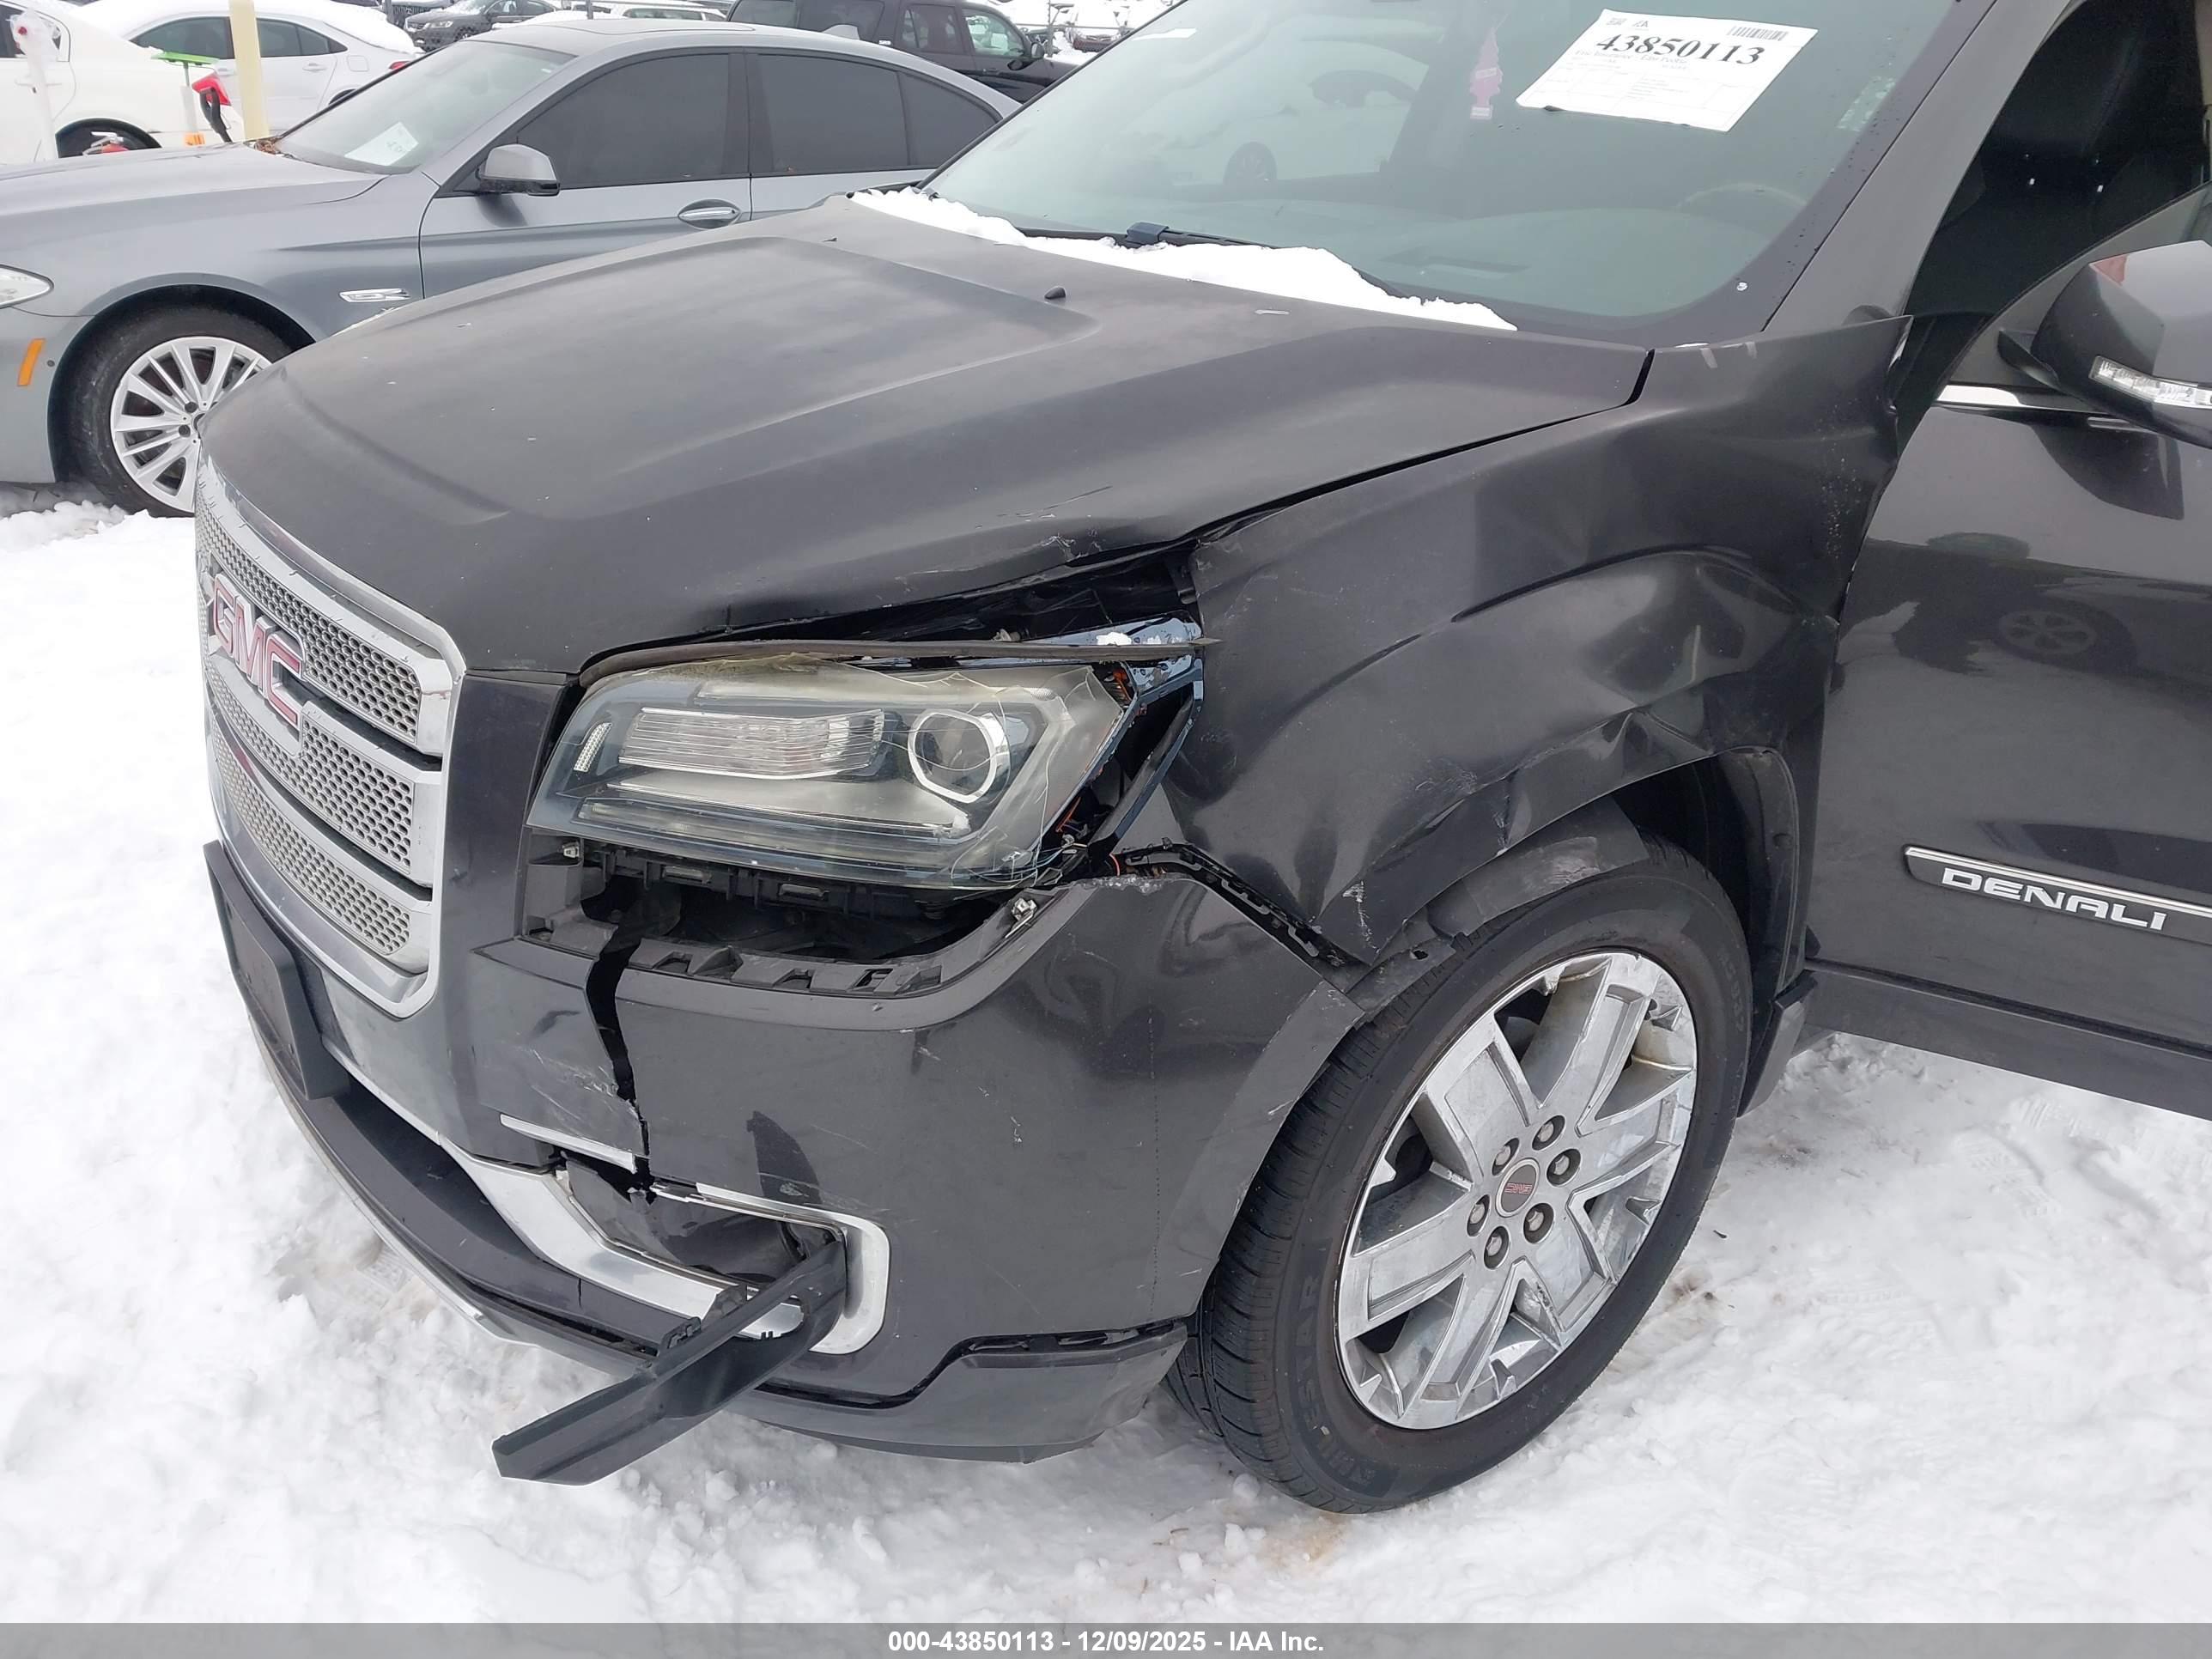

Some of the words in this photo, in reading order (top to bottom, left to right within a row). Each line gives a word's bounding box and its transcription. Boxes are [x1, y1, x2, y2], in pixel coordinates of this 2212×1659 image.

[1596, 33, 1765, 65] 43850113
[213, 574, 302, 729] GMC
[1942, 867, 2167, 931] DENALI
[1504, 1182, 1533, 1194] GMC
